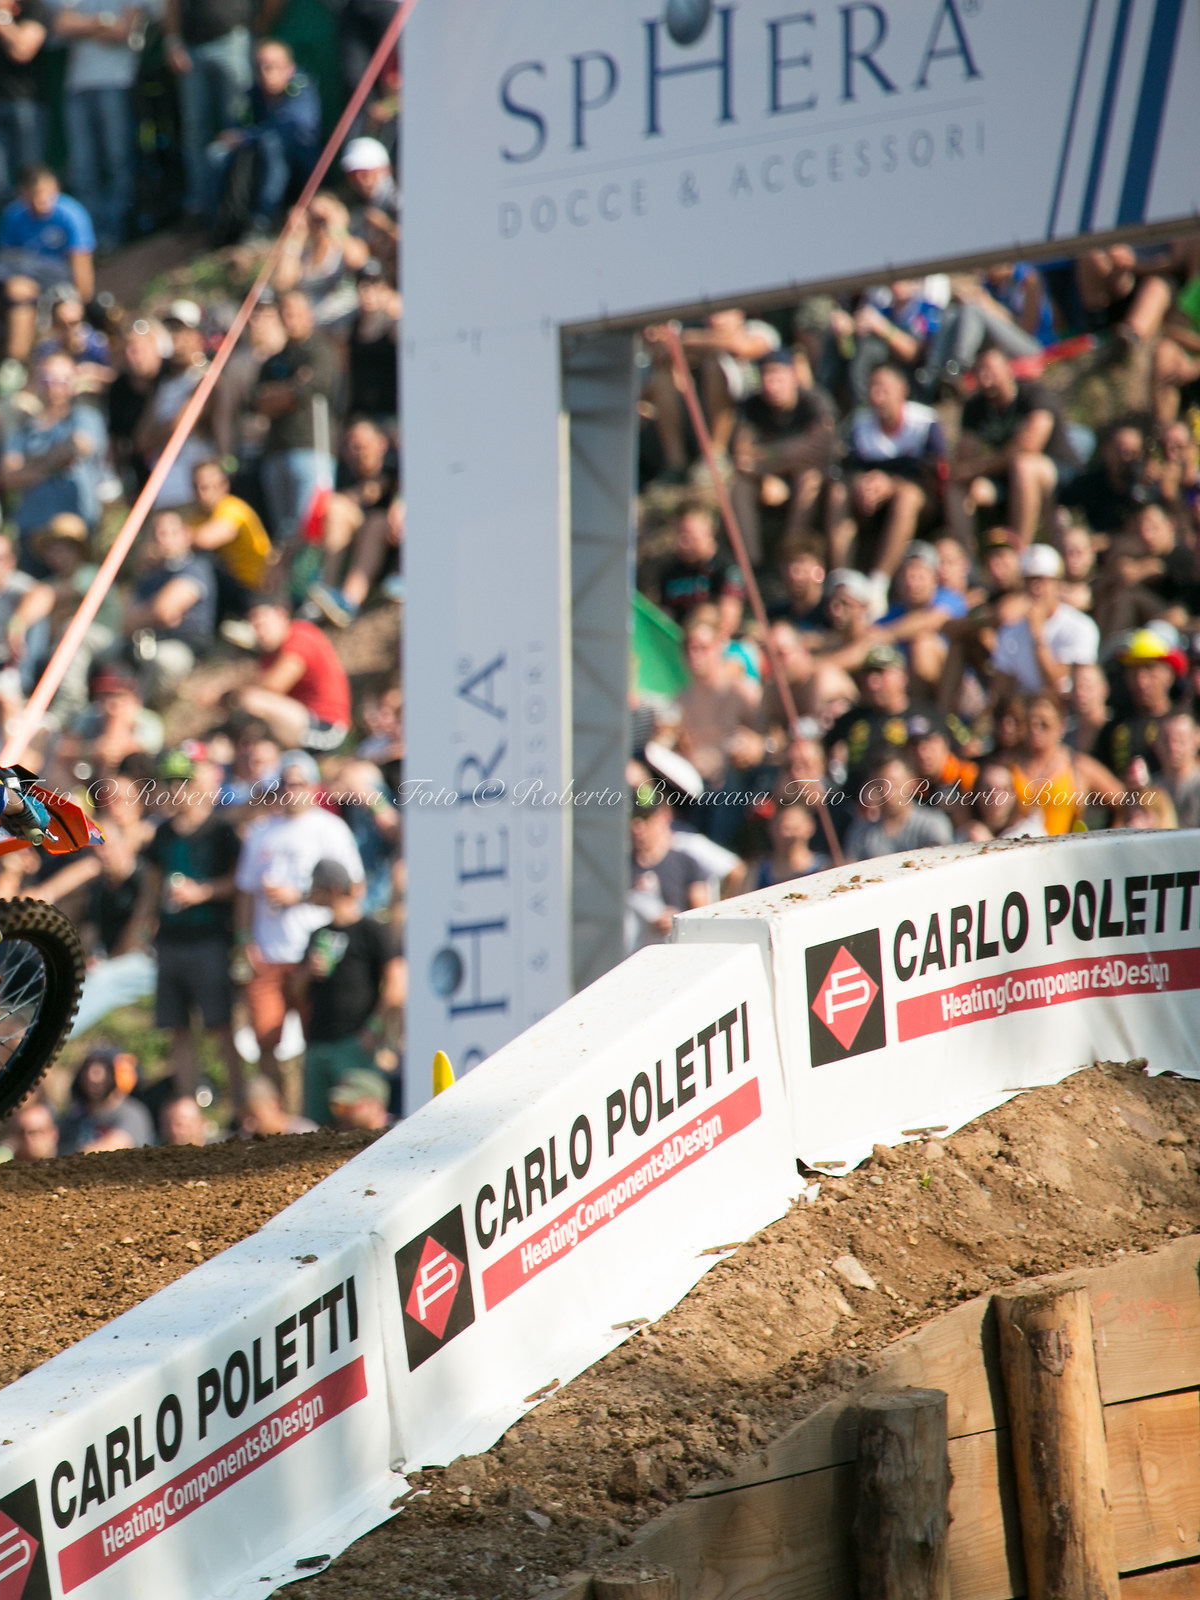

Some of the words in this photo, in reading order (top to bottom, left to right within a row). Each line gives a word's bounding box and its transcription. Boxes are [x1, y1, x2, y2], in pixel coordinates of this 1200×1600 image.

[500, 0, 983, 164] SPHERA
[500, 180, 648, 239] DOCCE
[677, 172, 702, 206] &
[729, 121, 987, 197] ACCESSORI
[894, 892, 1029, 982] CARLO
[1044, 870, 1200, 945] POLETT
[475, 1114, 592, 1250] CARLO
[606, 1001, 750, 1158] POLETTI
[520, 1115, 723, 1274] HeatingComponents&Design
[50, 1393, 183, 1530] CARLO
[198, 1275, 359, 1441] POLETTI
[101, 1392, 324, 1558] HeatingComponents&Design
